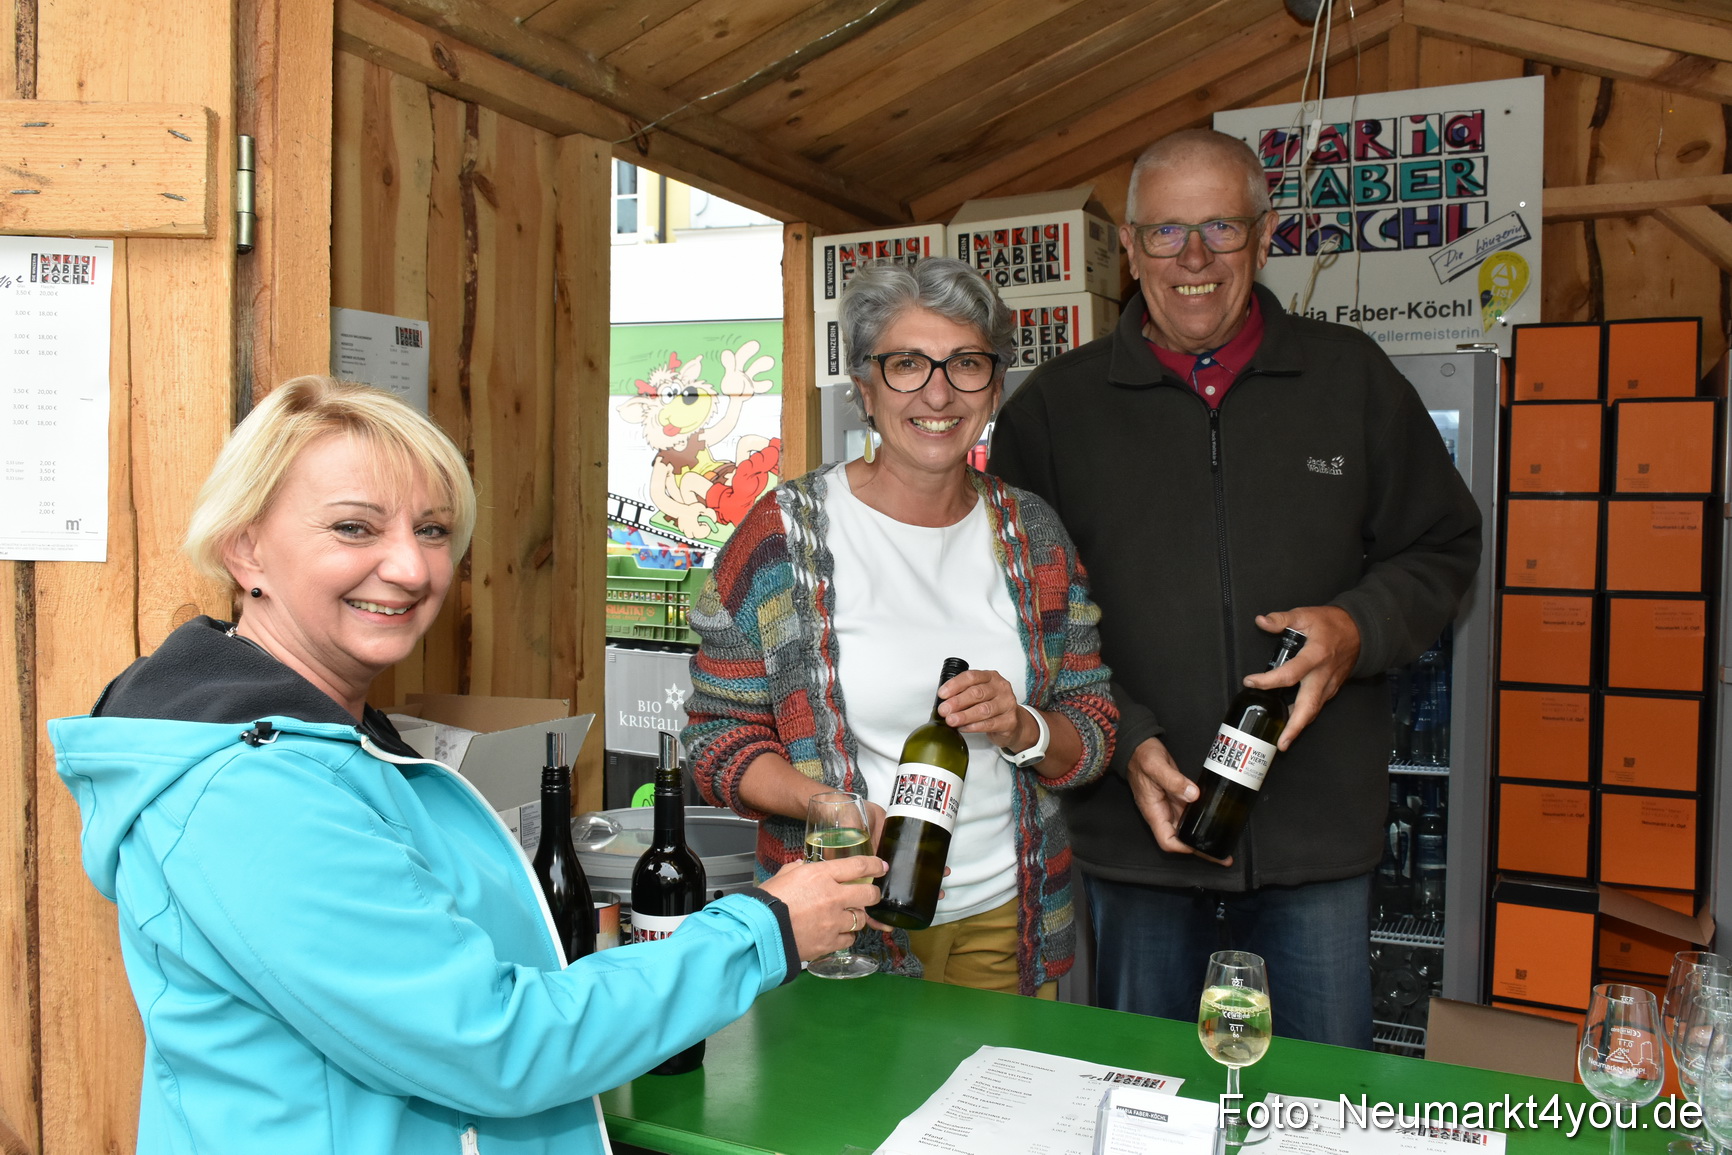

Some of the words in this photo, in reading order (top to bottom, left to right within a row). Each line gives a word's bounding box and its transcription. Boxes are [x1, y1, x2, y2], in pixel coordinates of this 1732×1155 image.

[1265, 155, 1488, 210] FABER
[975, 241, 1060, 269] FABER
[41, 263, 89, 275] FABER
[1336, 299, 1472, 322] Faber-Köchl
[1367, 327, 1480, 343] Kellermeisterin
[638, 700, 662, 713] BIO
[1252, 750, 1266, 759] WEIN
[898, 784, 945, 801] FABER
